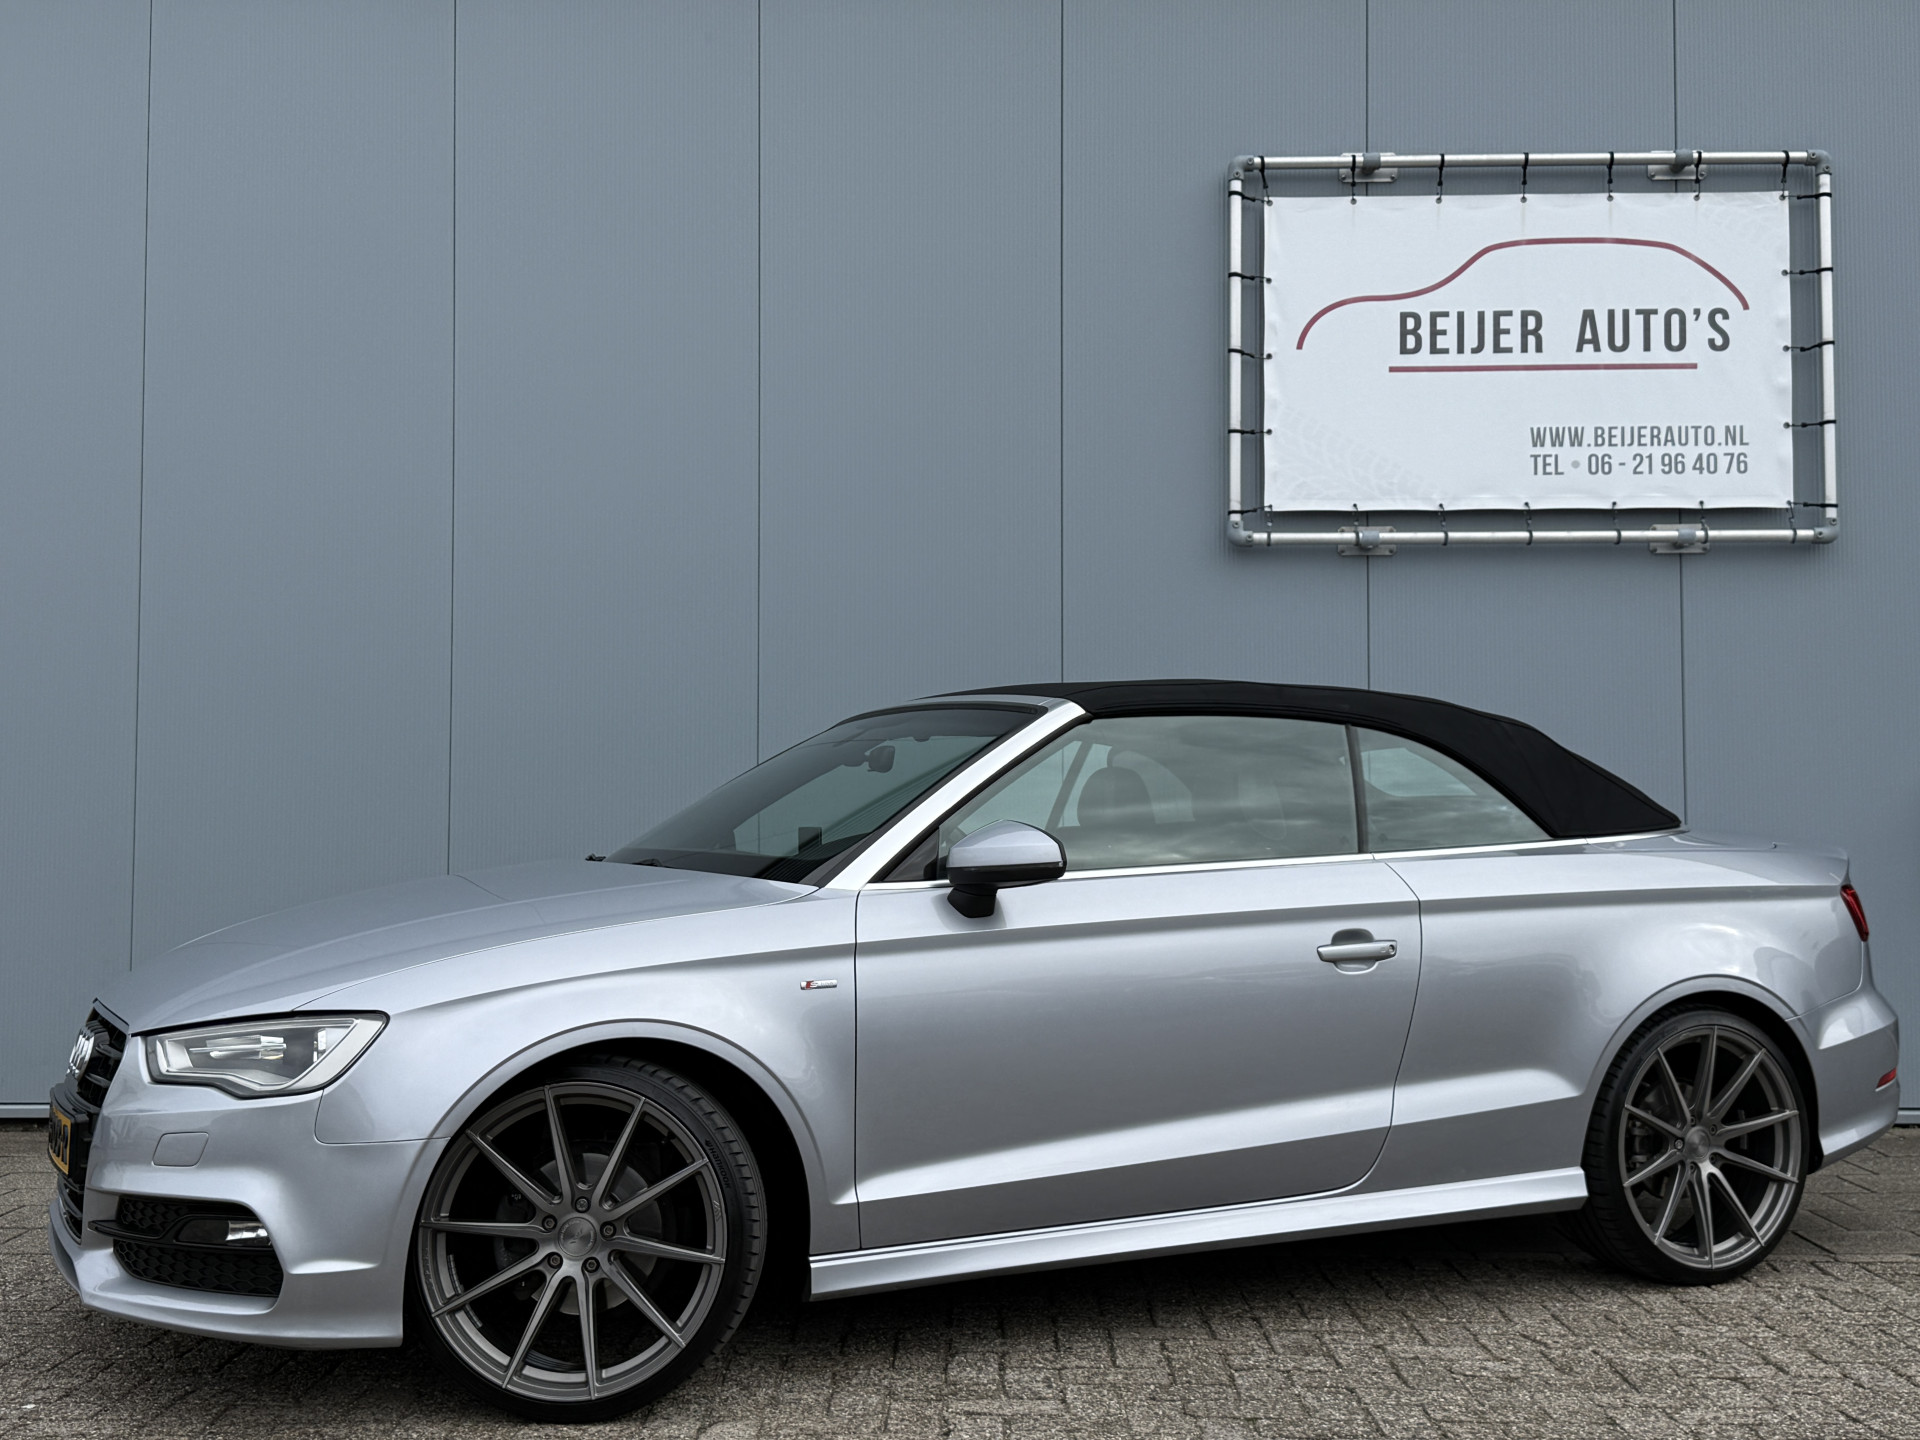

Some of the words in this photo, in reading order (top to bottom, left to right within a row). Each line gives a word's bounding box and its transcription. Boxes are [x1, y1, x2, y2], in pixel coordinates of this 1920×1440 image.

[1399, 310, 1544, 355] BEIJER
[1575, 307, 1731, 353] AUTO'S
[1529, 425, 1750, 448] WWW.BEIJERAUTO.NL
[1529, 454, 1565, 476] TEL
[1587, 453, 1613, 476] 06
[1632, 453, 1654, 475] 21
[1660, 453, 1686, 475] 96
[1691, 452, 1718, 475] 40
[1723, 452, 1749, 475] 76
